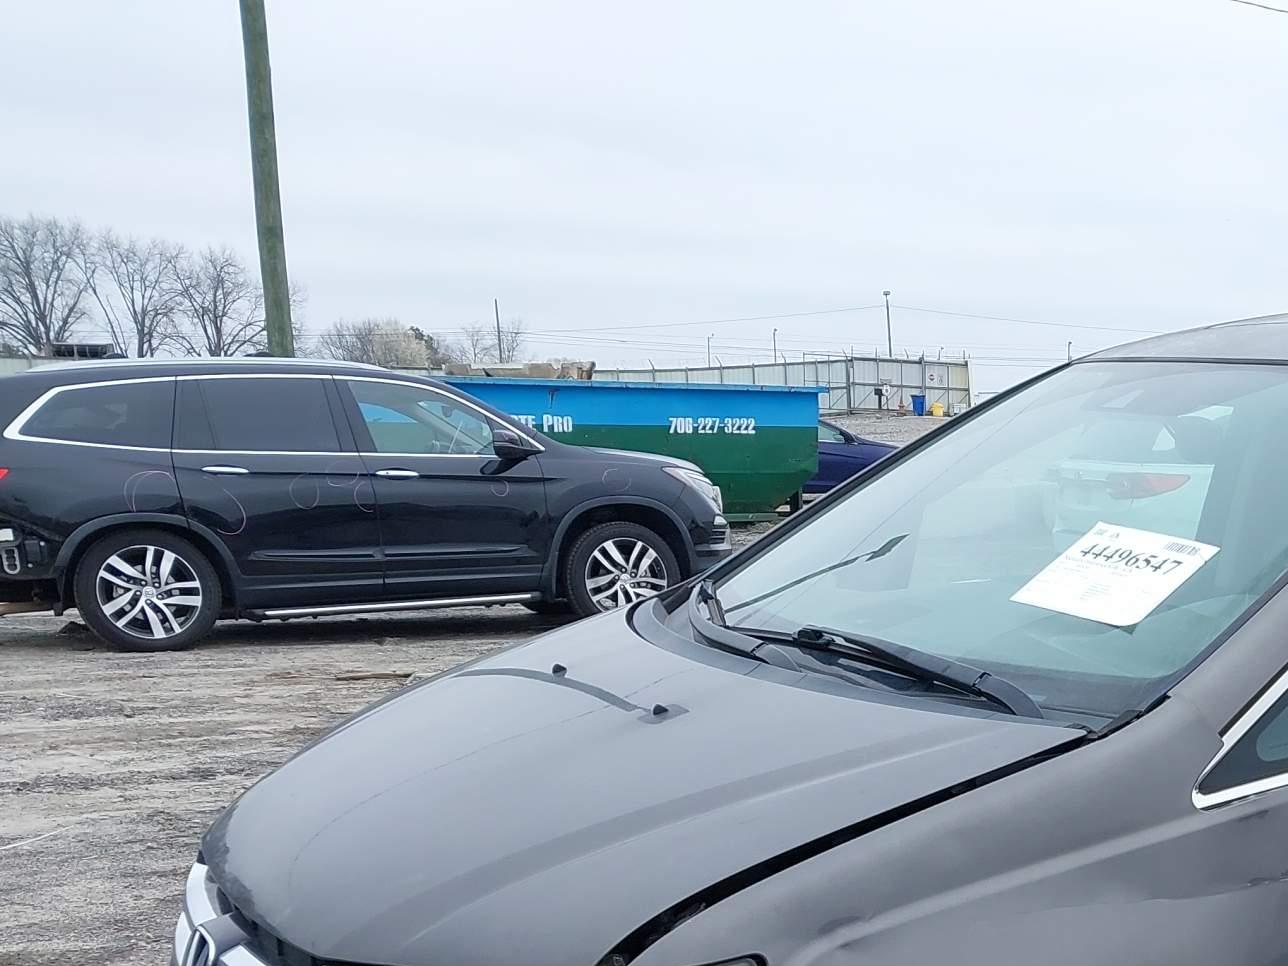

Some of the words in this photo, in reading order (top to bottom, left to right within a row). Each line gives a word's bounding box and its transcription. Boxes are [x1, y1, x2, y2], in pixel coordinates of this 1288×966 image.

[543, 414, 573, 433] PRO
[669, 417, 756, 434] 706-227-3222
[1080, 544, 1183, 575] 44496547
